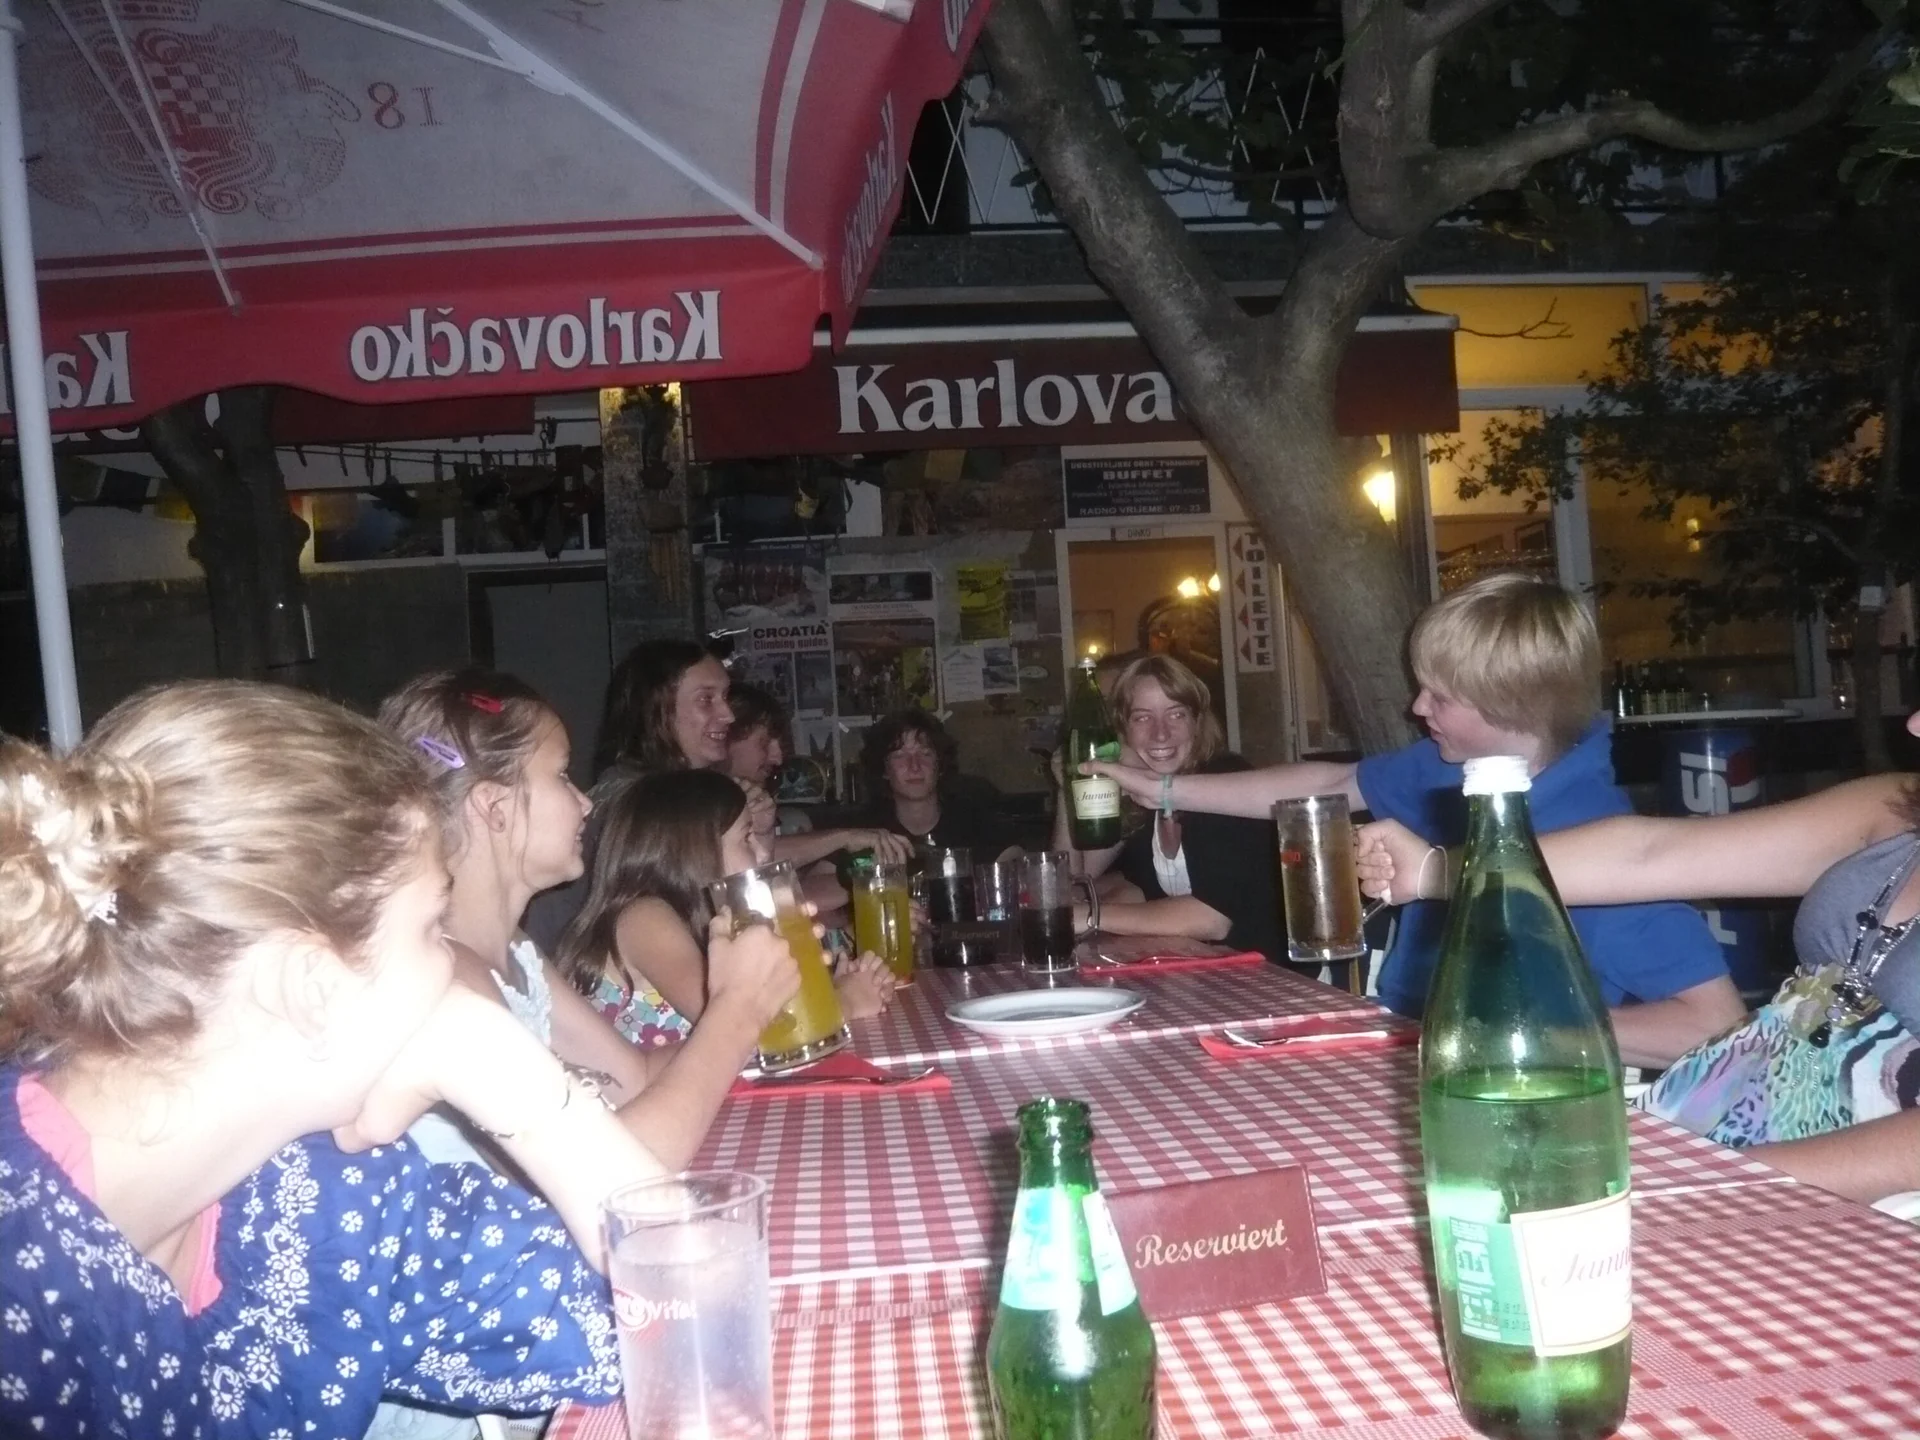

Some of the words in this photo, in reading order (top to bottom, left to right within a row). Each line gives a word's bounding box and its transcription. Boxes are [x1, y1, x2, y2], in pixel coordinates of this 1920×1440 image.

[832, 358, 1177, 434] Karlova
[1103, 469, 1174, 480] BUFFET
[1080, 506, 1116, 515] RADNO
[753, 625, 827, 639] CROATIA
[754, 638, 795, 650] Climbing
[798, 637, 828, 649] guides
[1135, 1219, 1288, 1269] Reserviert
